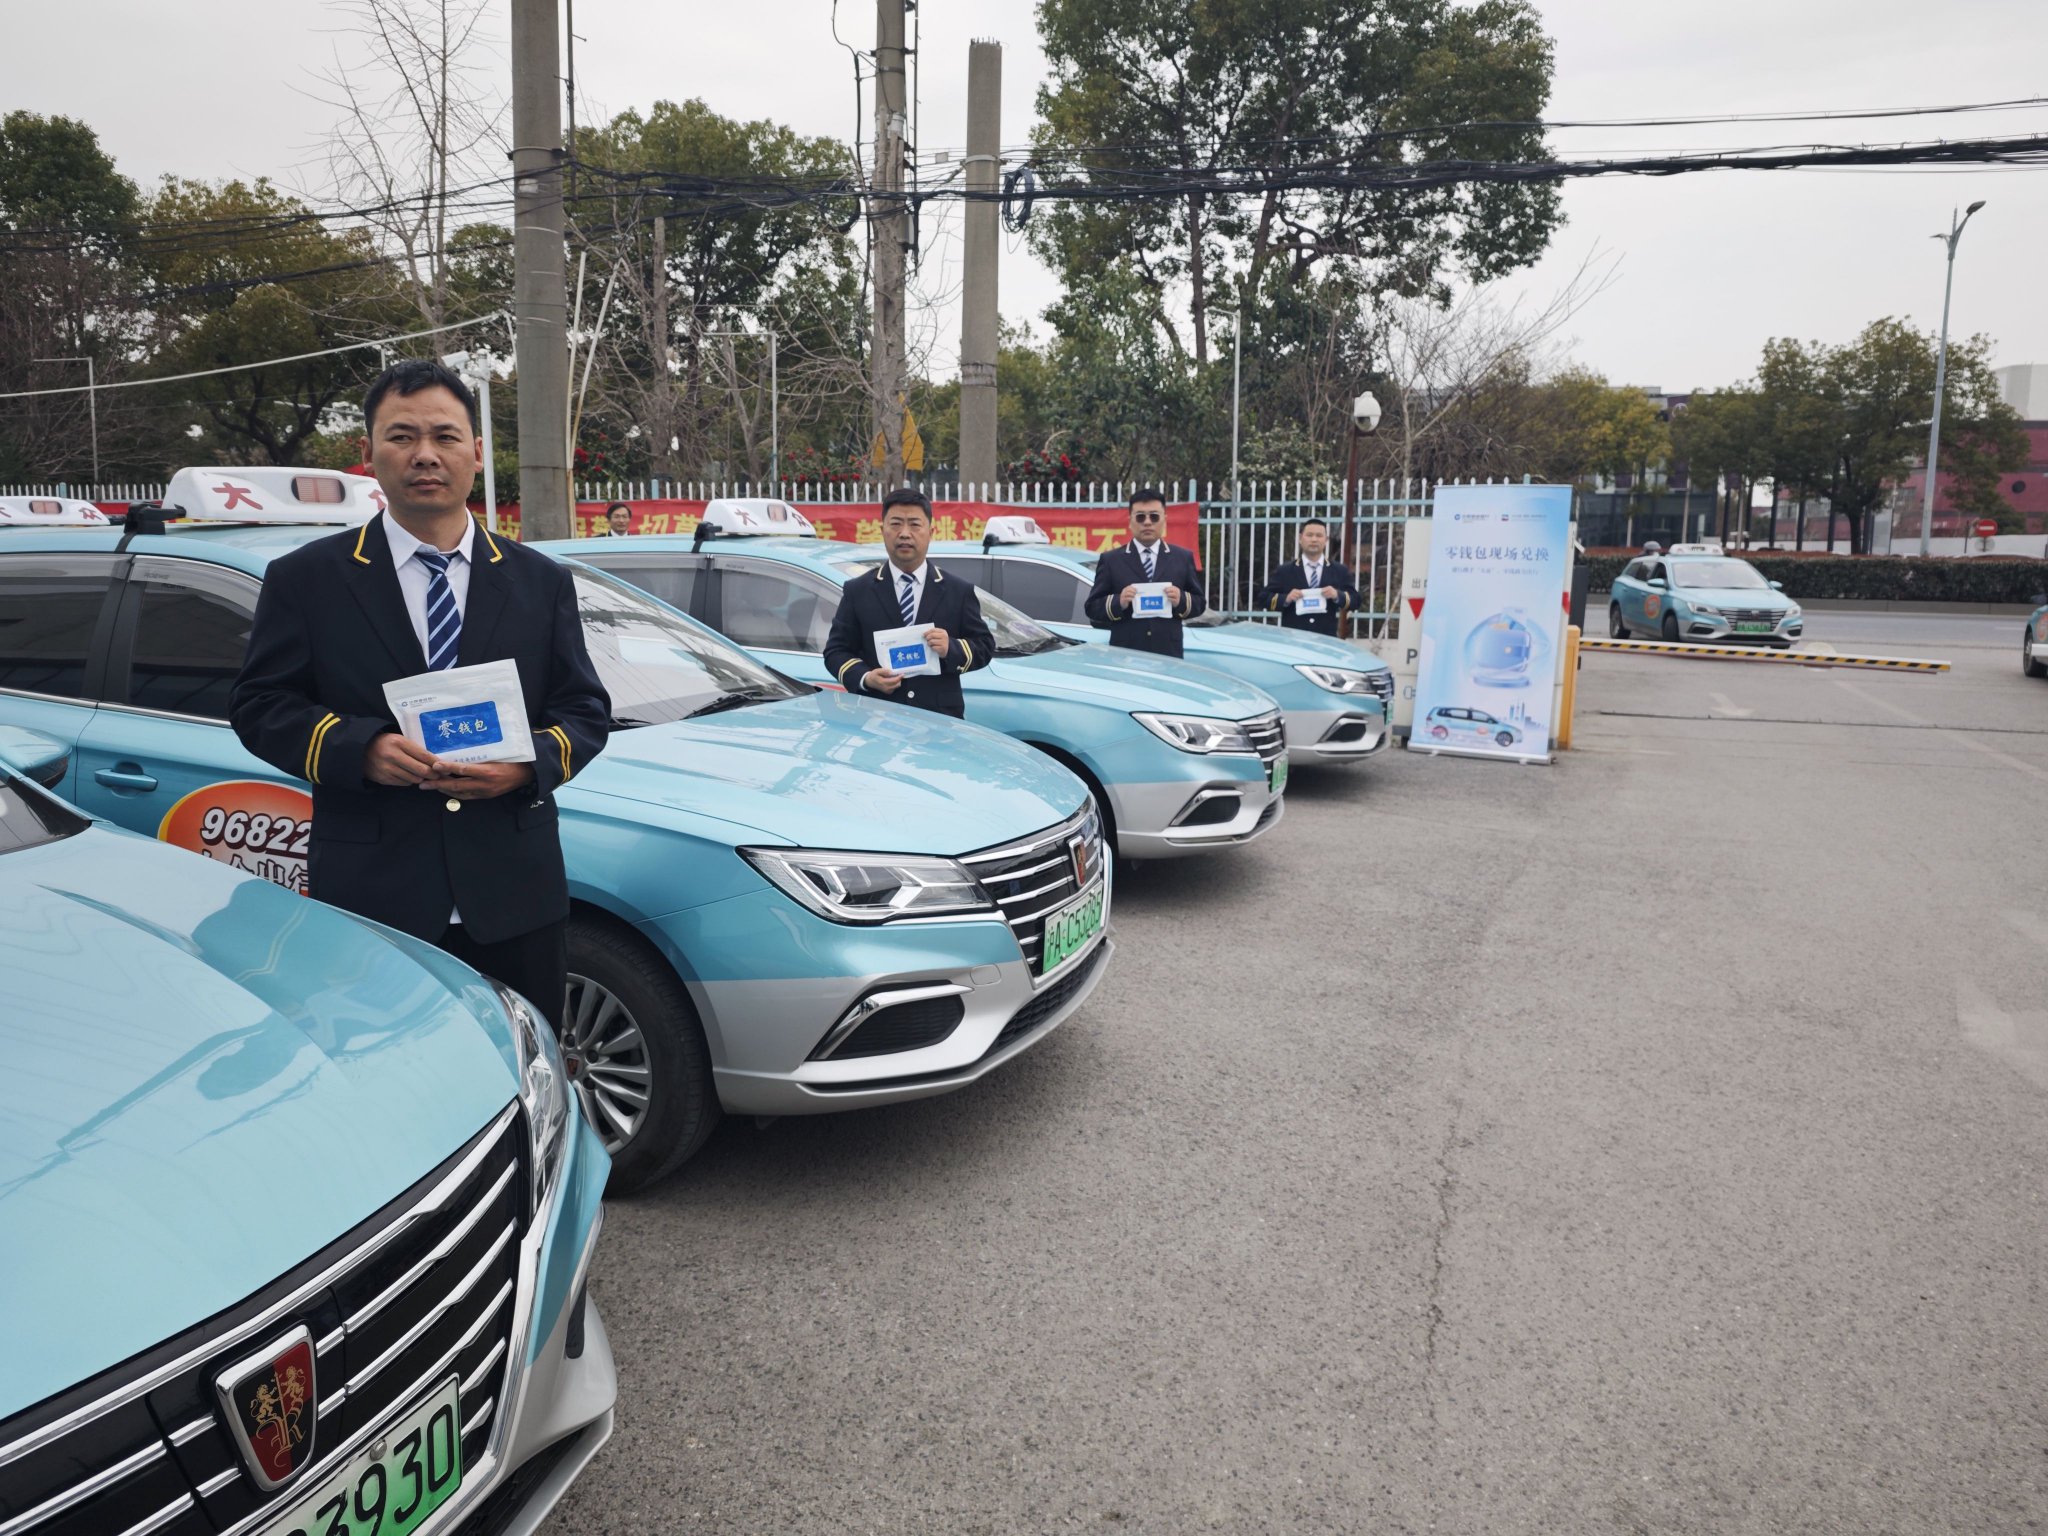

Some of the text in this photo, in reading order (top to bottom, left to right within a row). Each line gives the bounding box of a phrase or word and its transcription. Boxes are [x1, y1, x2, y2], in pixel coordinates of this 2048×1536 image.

[213, 481, 264, 511] 大
[1445, 545, 1549, 561] 零钱包现场兑换
[1406, 648, 1418, 665] P
[437, 718, 488, 739] 零钱包
[201, 807, 312, 858] 96822
[284, 1403, 454, 1536] 3930
